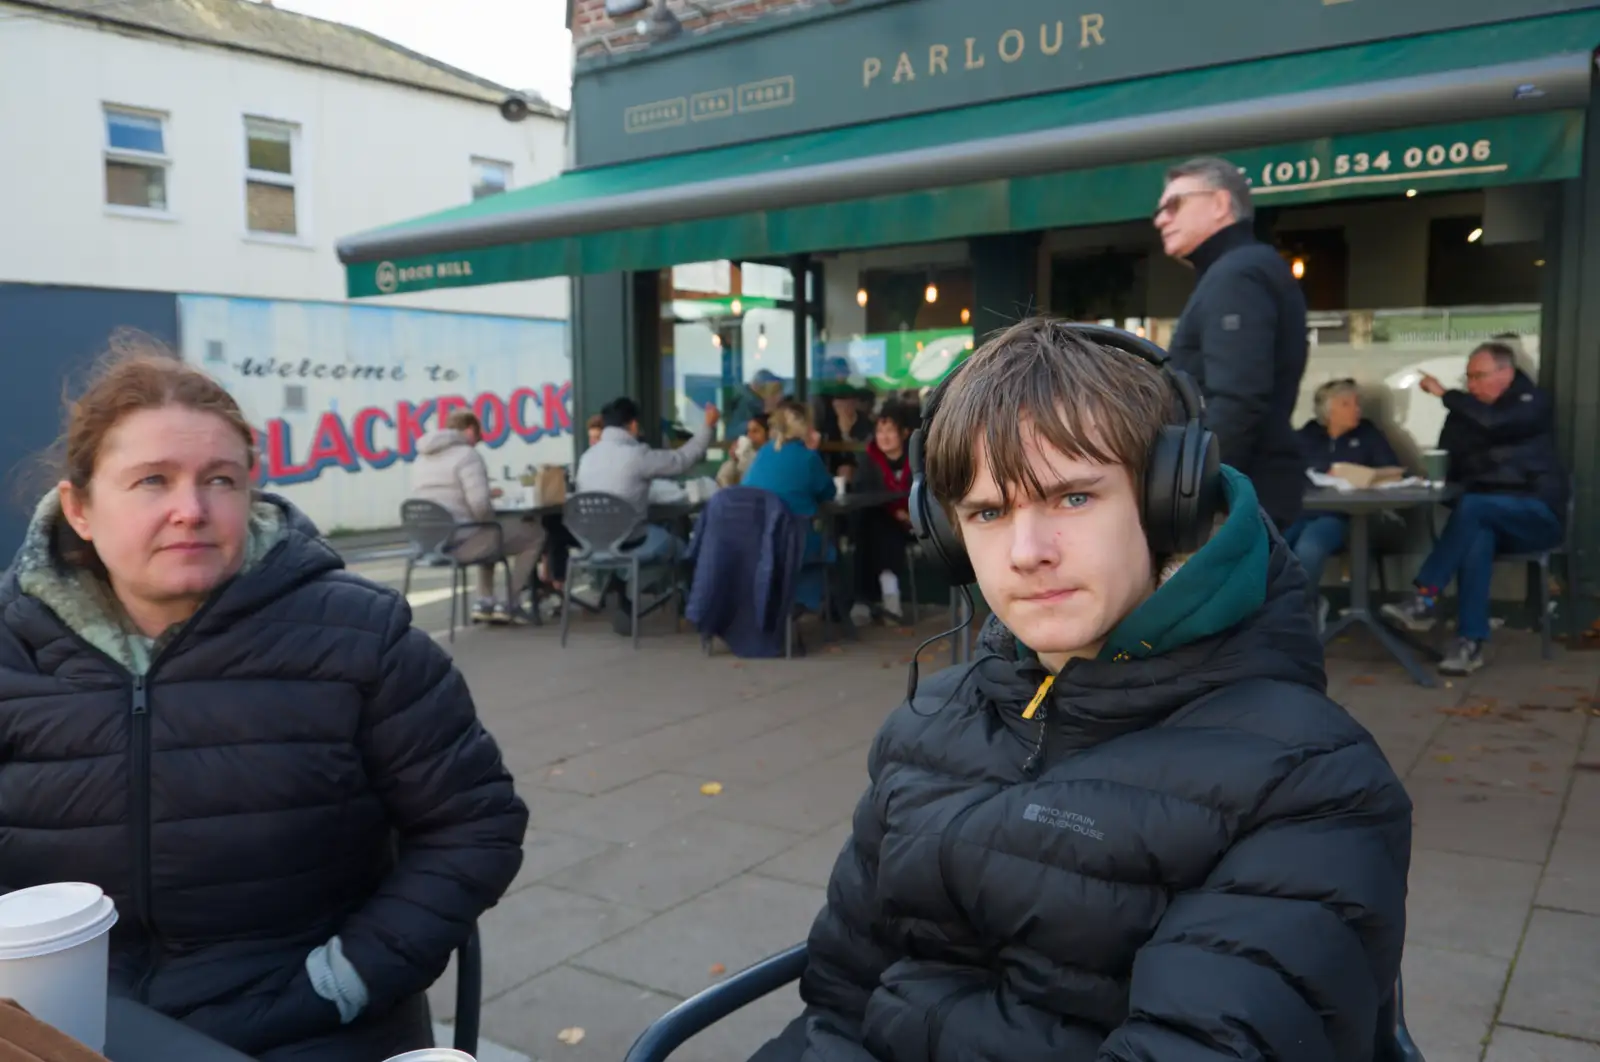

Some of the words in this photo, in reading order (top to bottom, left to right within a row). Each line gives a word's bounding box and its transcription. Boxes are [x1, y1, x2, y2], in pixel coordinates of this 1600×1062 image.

[862, 13, 1105, 88] PARLOUR
[1262, 158, 1320, 185] (01)
[1335, 151, 1391, 175] 534
[1403, 140, 1491, 168] 0006
[425, 364, 459, 382] to
